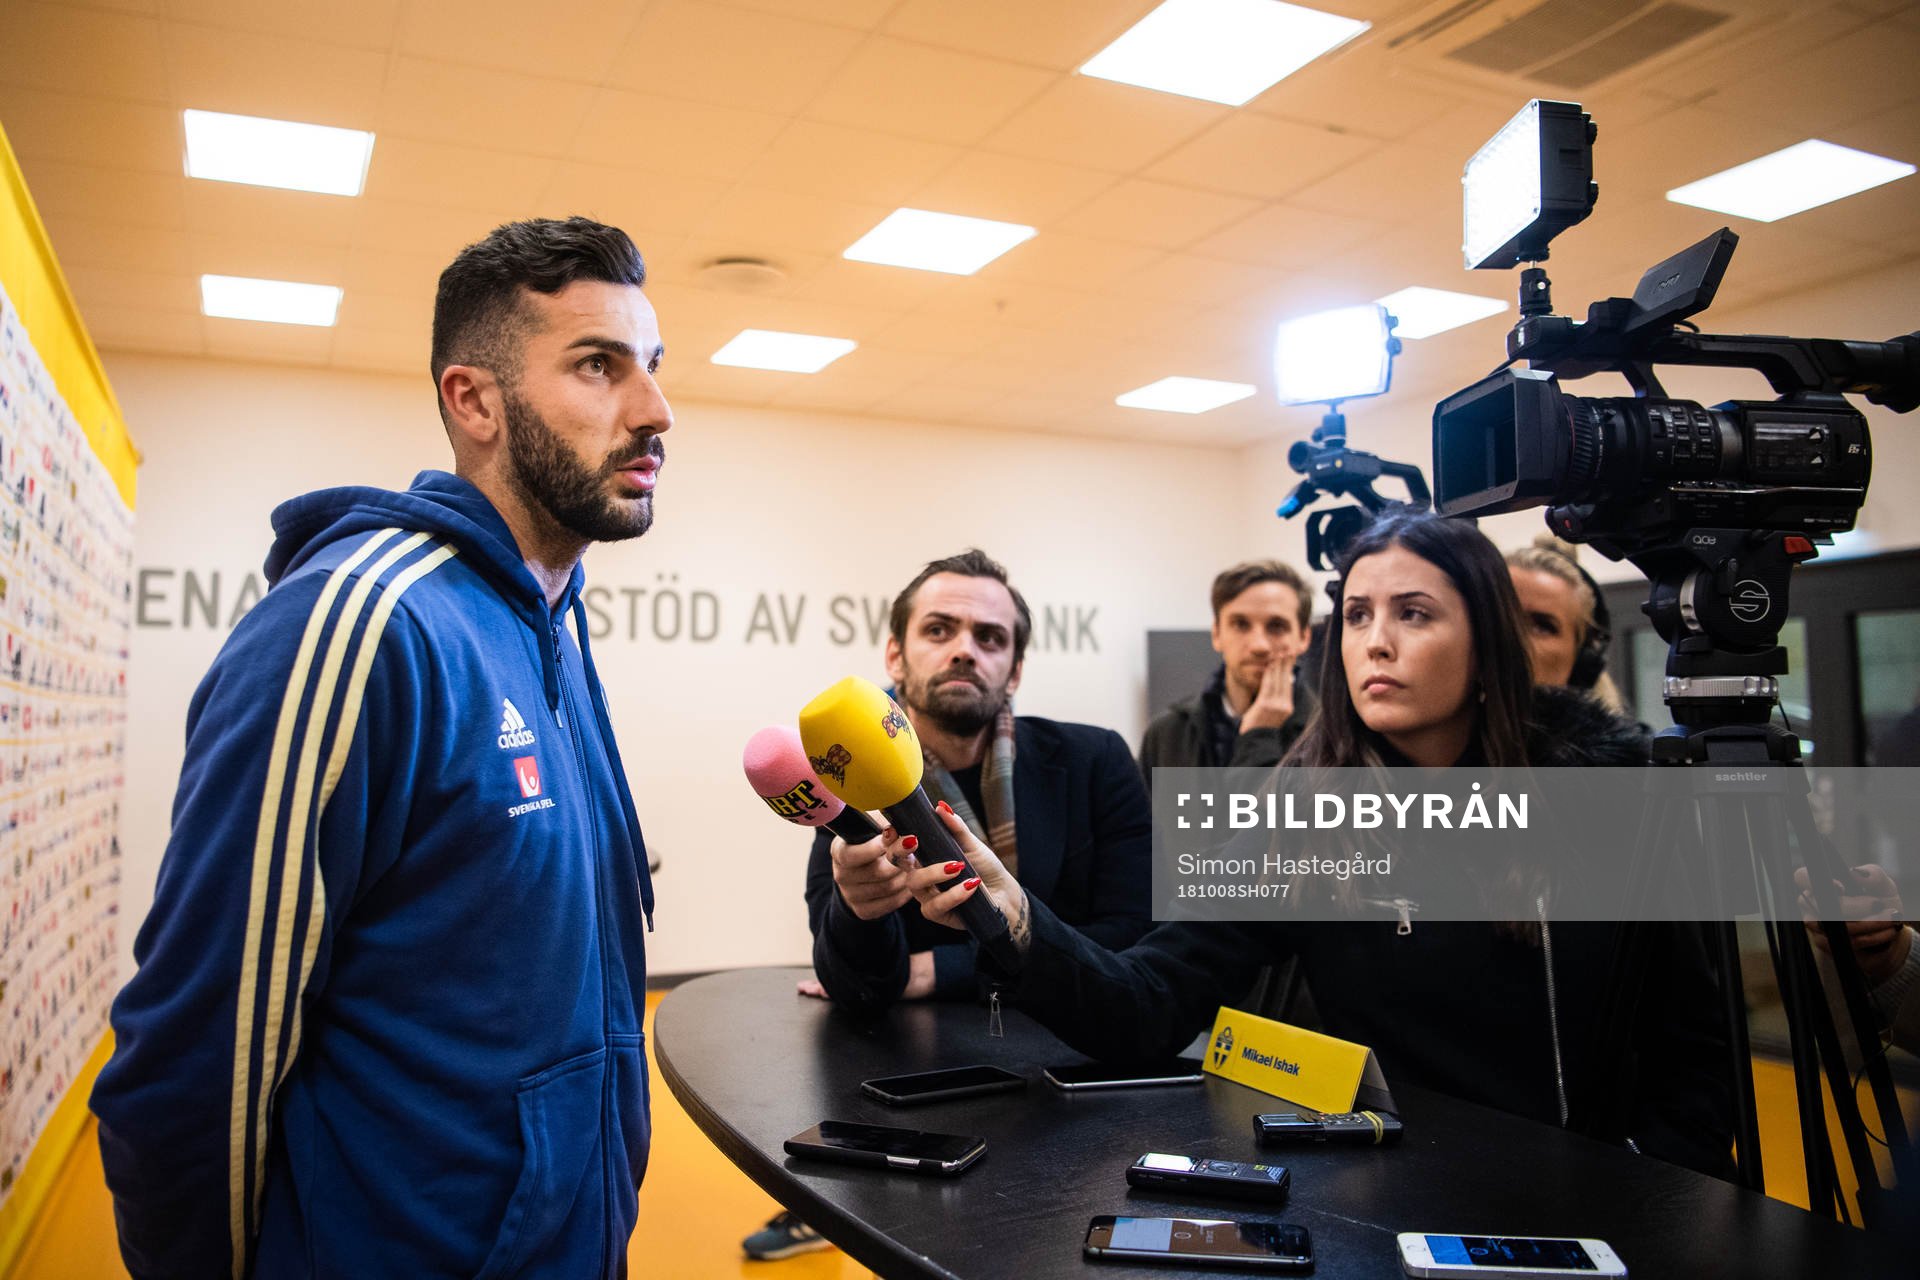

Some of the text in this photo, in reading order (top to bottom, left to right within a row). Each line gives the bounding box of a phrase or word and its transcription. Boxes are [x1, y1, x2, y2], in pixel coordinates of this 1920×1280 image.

[584, 572, 721, 643] STÖD
[744, 592, 807, 645] AV
[498, 729, 536, 750] adidas
[1715, 771, 1768, 782] sachtler
[1242, 1046, 1300, 1076] Mikael Ishak
